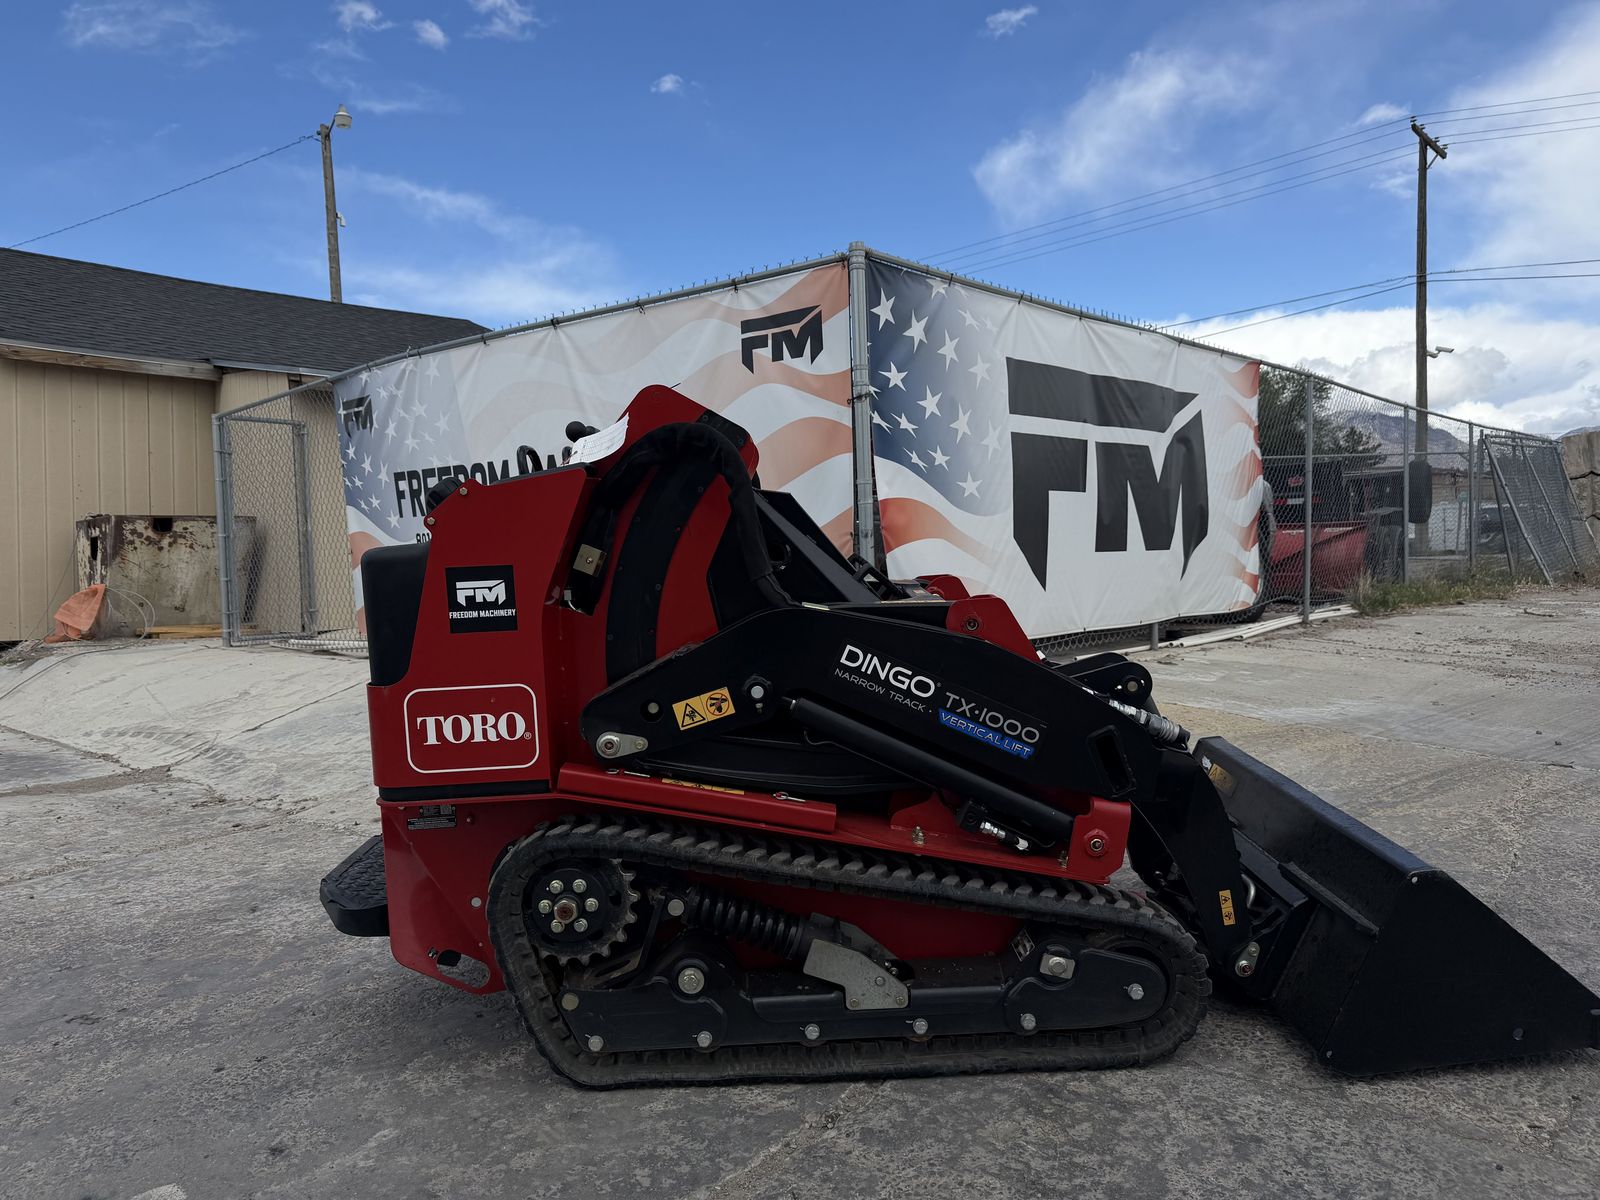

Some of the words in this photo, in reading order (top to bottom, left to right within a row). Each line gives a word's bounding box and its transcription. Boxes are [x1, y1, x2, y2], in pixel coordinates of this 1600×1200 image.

[740, 304, 824, 375] FM
[1005, 356, 1209, 592] FM
[449, 610, 479, 620] FREEDOM
[479, 608, 516, 618] MACHINERY
[455, 579, 507, 607] FM
[840, 644, 936, 698] DINGO
[834, 667, 886, 695] NARROW
[889, 690, 926, 713] TRACK
[941, 712, 1001, 745] VERTICAL
[1003, 738, 1031, 756] LIFT
